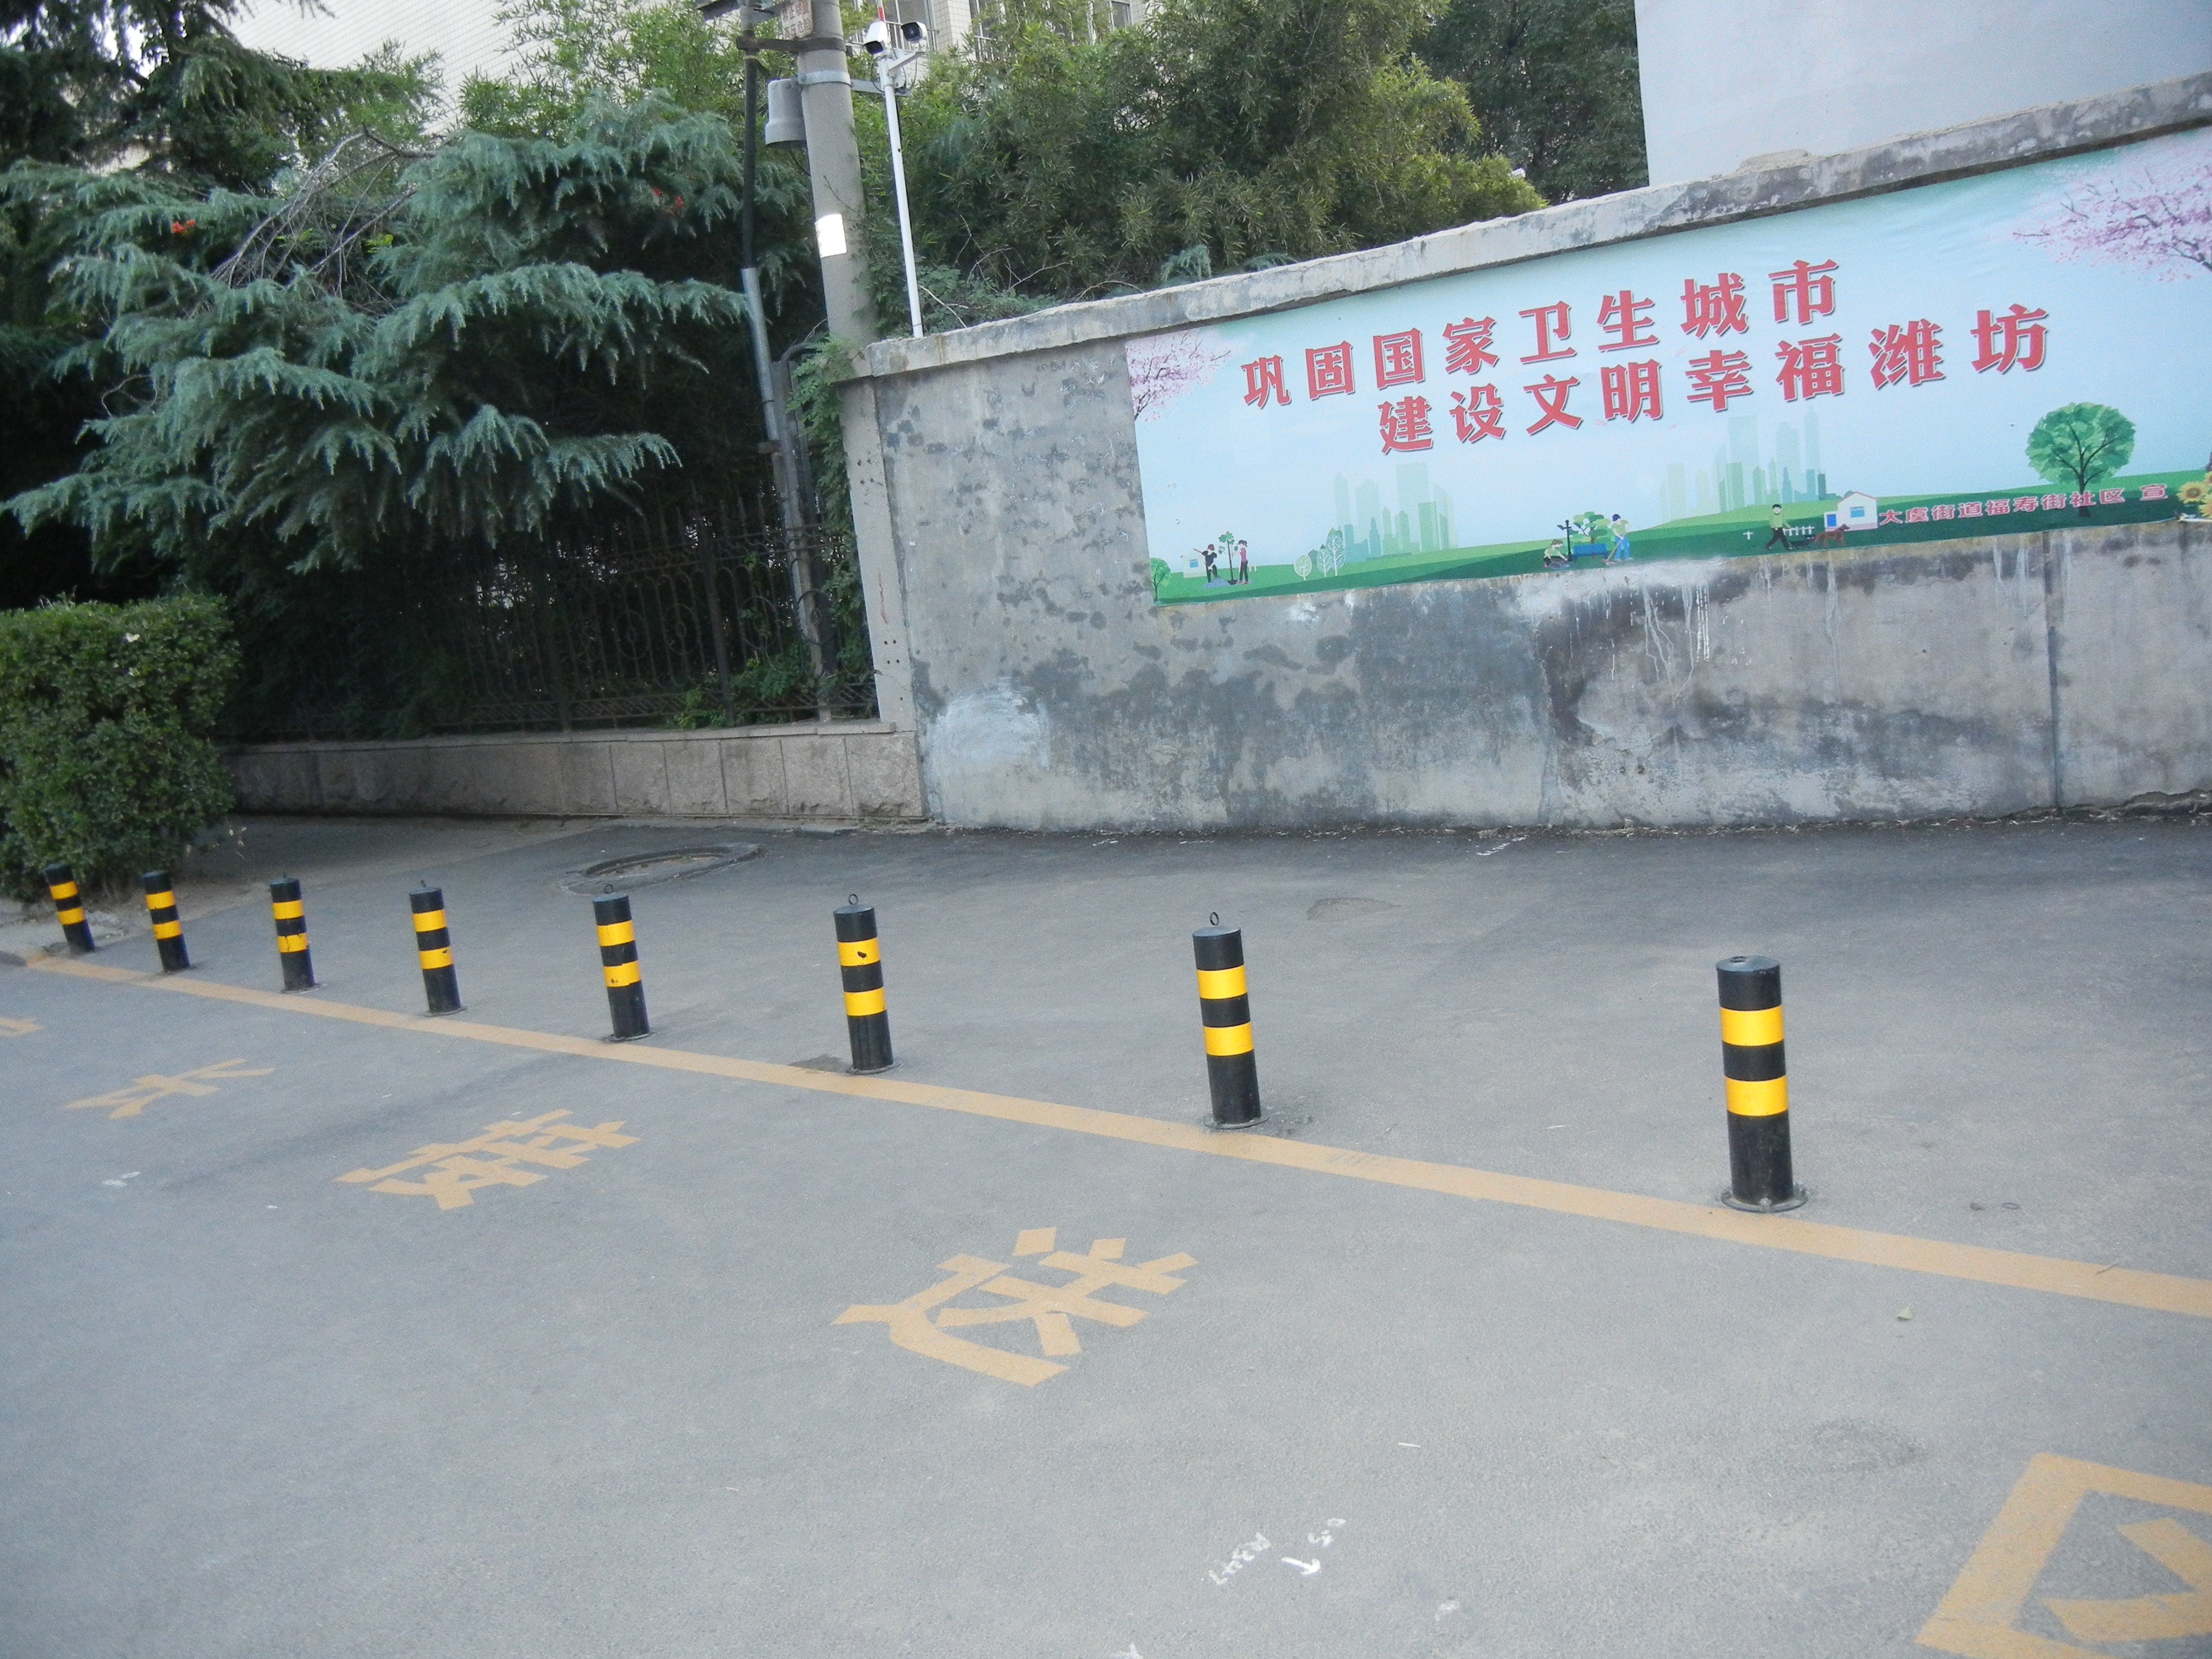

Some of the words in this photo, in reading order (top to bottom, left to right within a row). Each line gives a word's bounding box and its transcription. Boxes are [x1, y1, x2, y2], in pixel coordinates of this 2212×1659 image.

[784, 18, 811, 36] 高压危险
[1243, 258, 1839, 408] 巩固国家卫生城市
[1378, 303, 2048, 455] 建设文明幸福潍坊
[1879, 488, 2125, 525] 大虞街道福寿街社区
[2140, 484, 2168, 500] 宣
